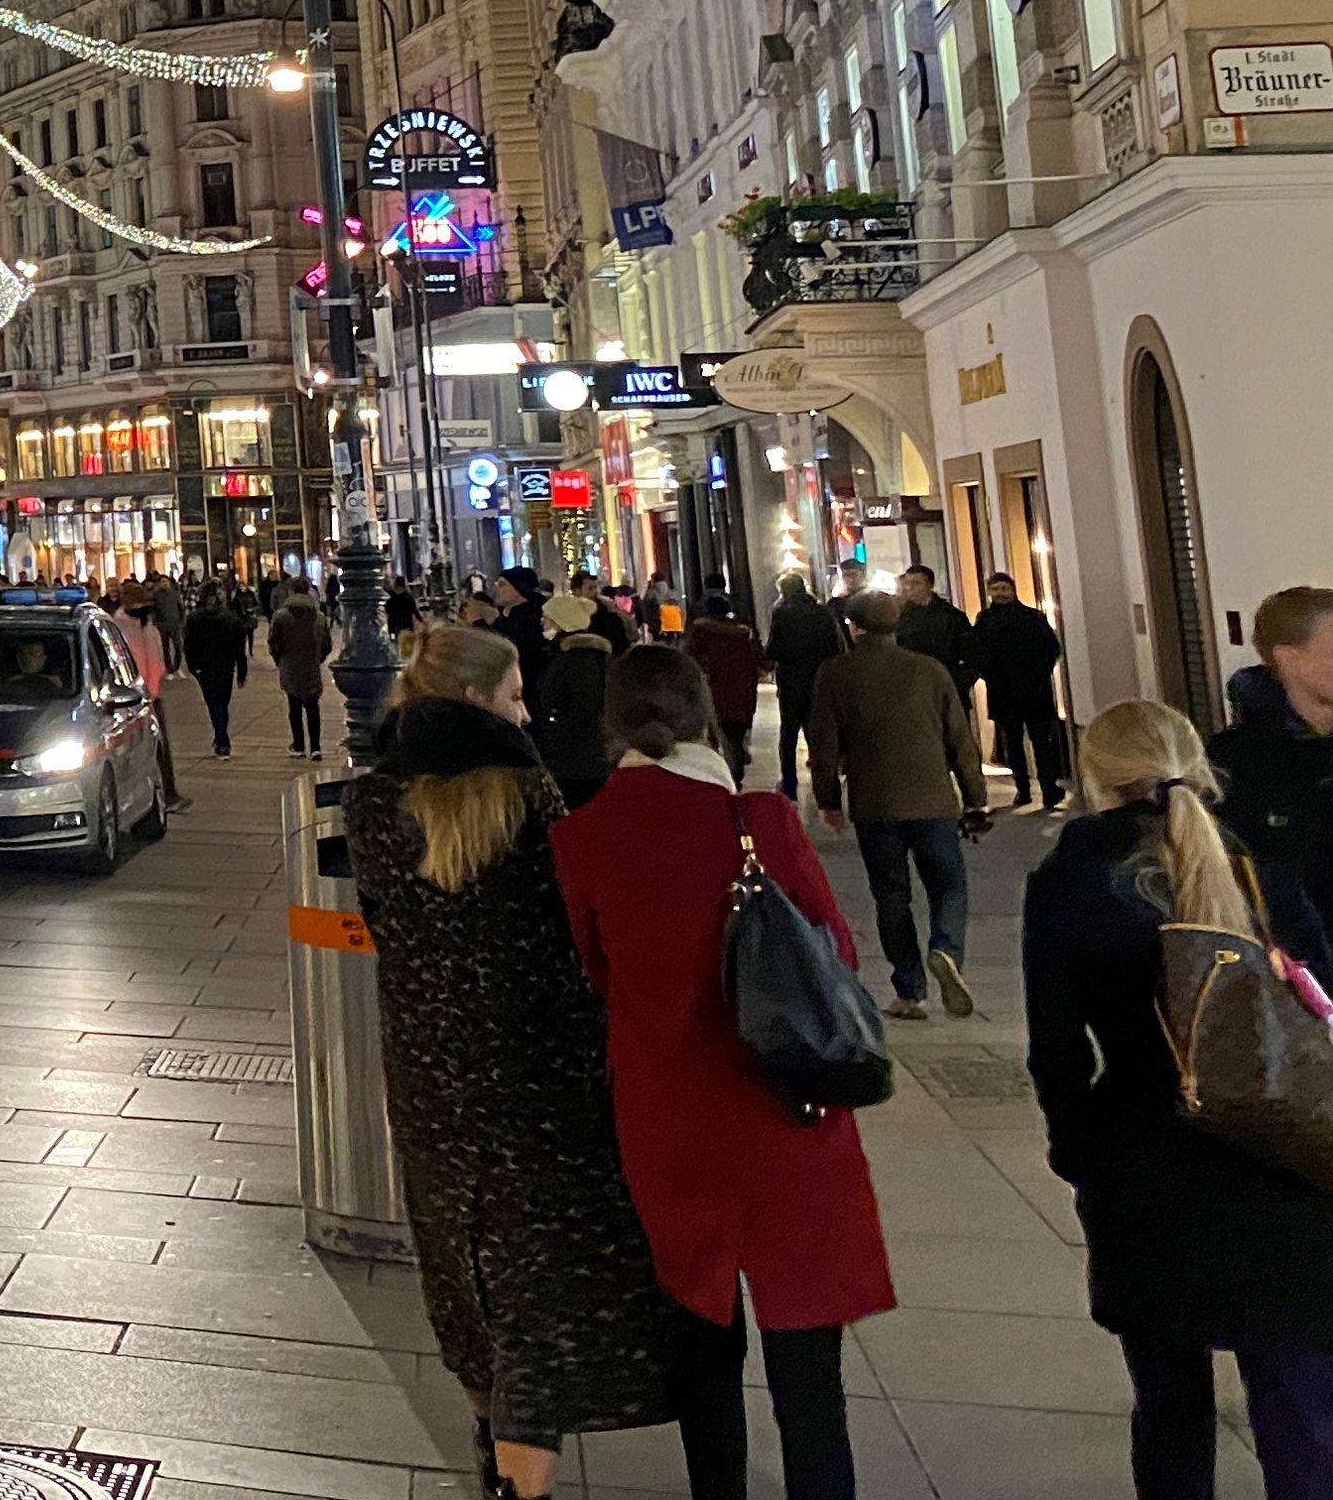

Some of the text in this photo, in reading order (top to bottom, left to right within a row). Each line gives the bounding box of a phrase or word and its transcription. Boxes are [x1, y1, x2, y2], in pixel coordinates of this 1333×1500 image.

[1258, 50, 1295, 64] Stadt
[1220, 67, 1331, 97] Bräuner-
[391, 157, 461, 173] BUFFET
[626, 372, 673, 392] IWC
[611, 393, 691, 404] SCHAFFHAUSEN
